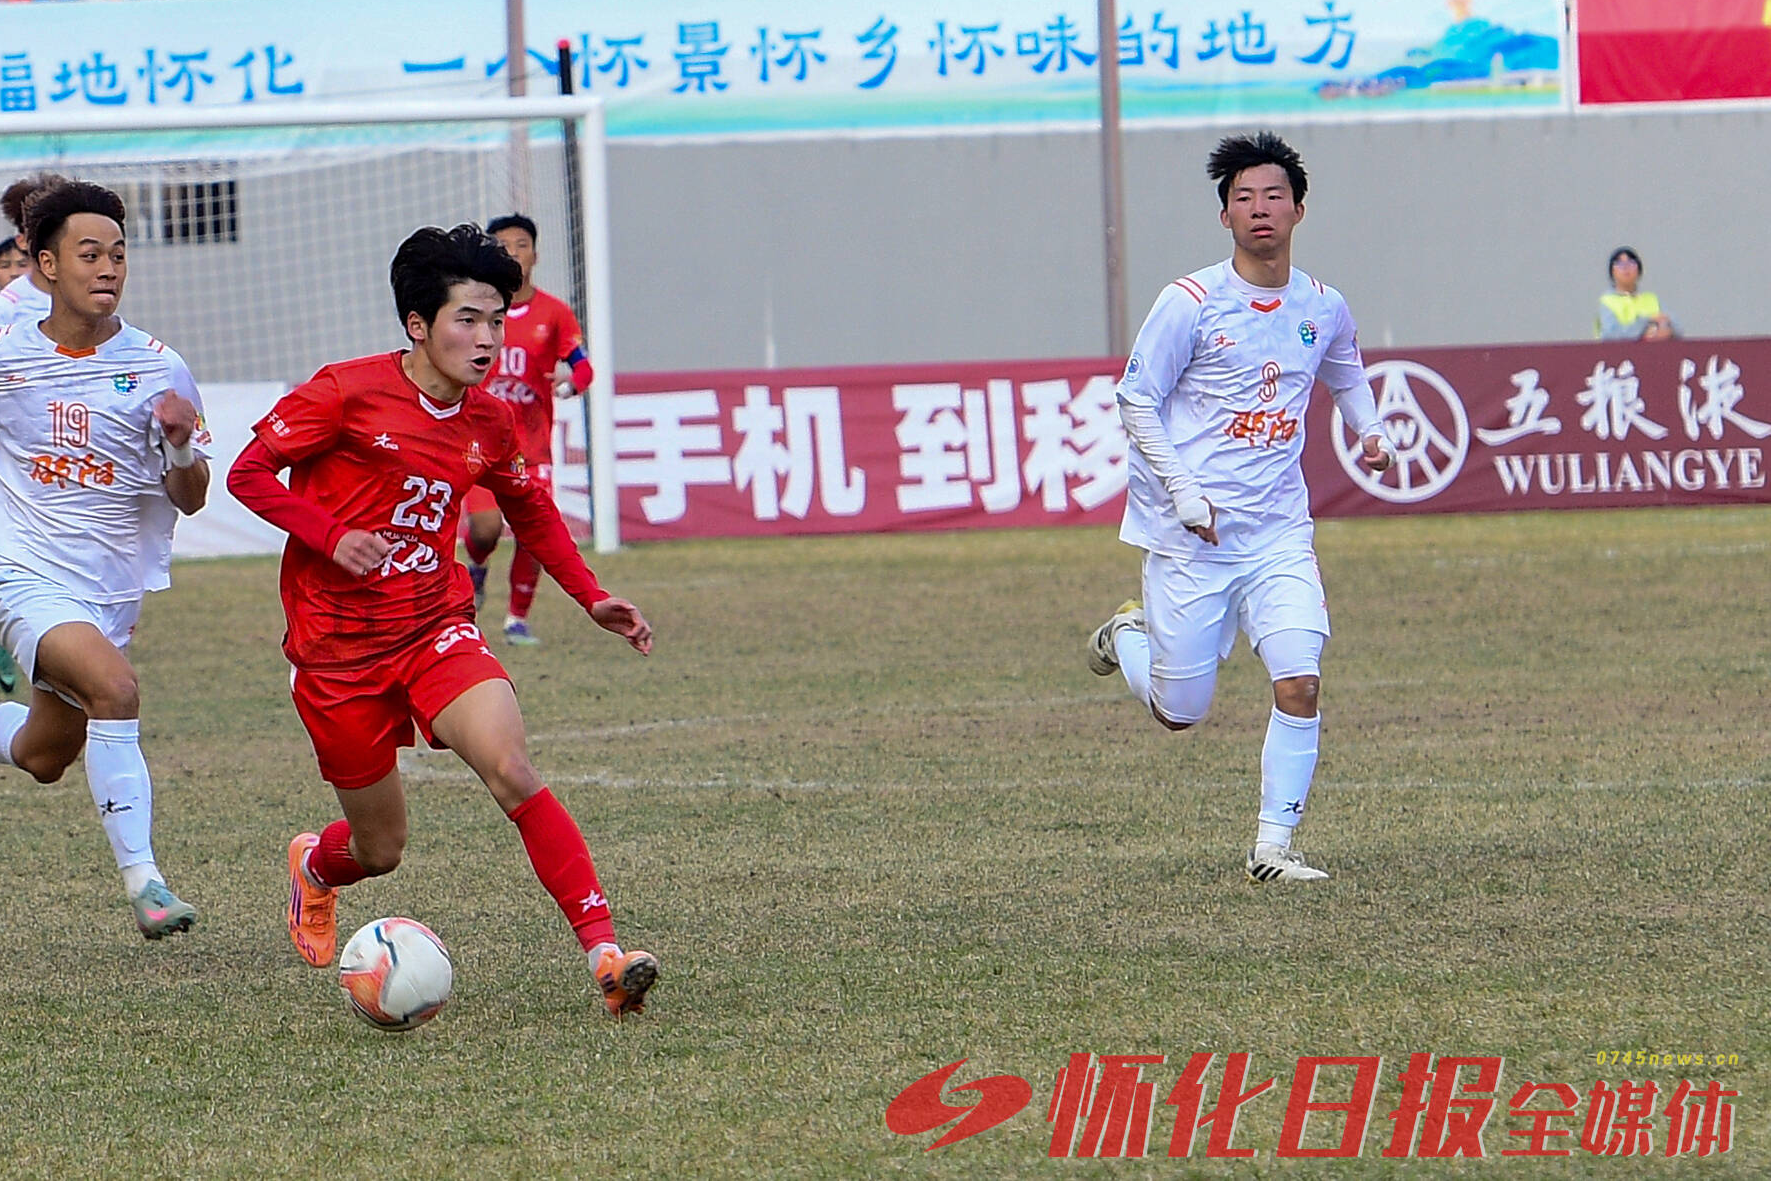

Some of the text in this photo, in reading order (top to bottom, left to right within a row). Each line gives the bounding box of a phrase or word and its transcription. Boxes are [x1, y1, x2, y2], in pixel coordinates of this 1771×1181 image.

[498, 346, 527, 377] 10
[1476, 356, 1771, 443] 五粮液
[47, 401, 91, 448] 19
[1494, 448, 1766, 495] WULIANGYE
[391, 475, 453, 532] 23
